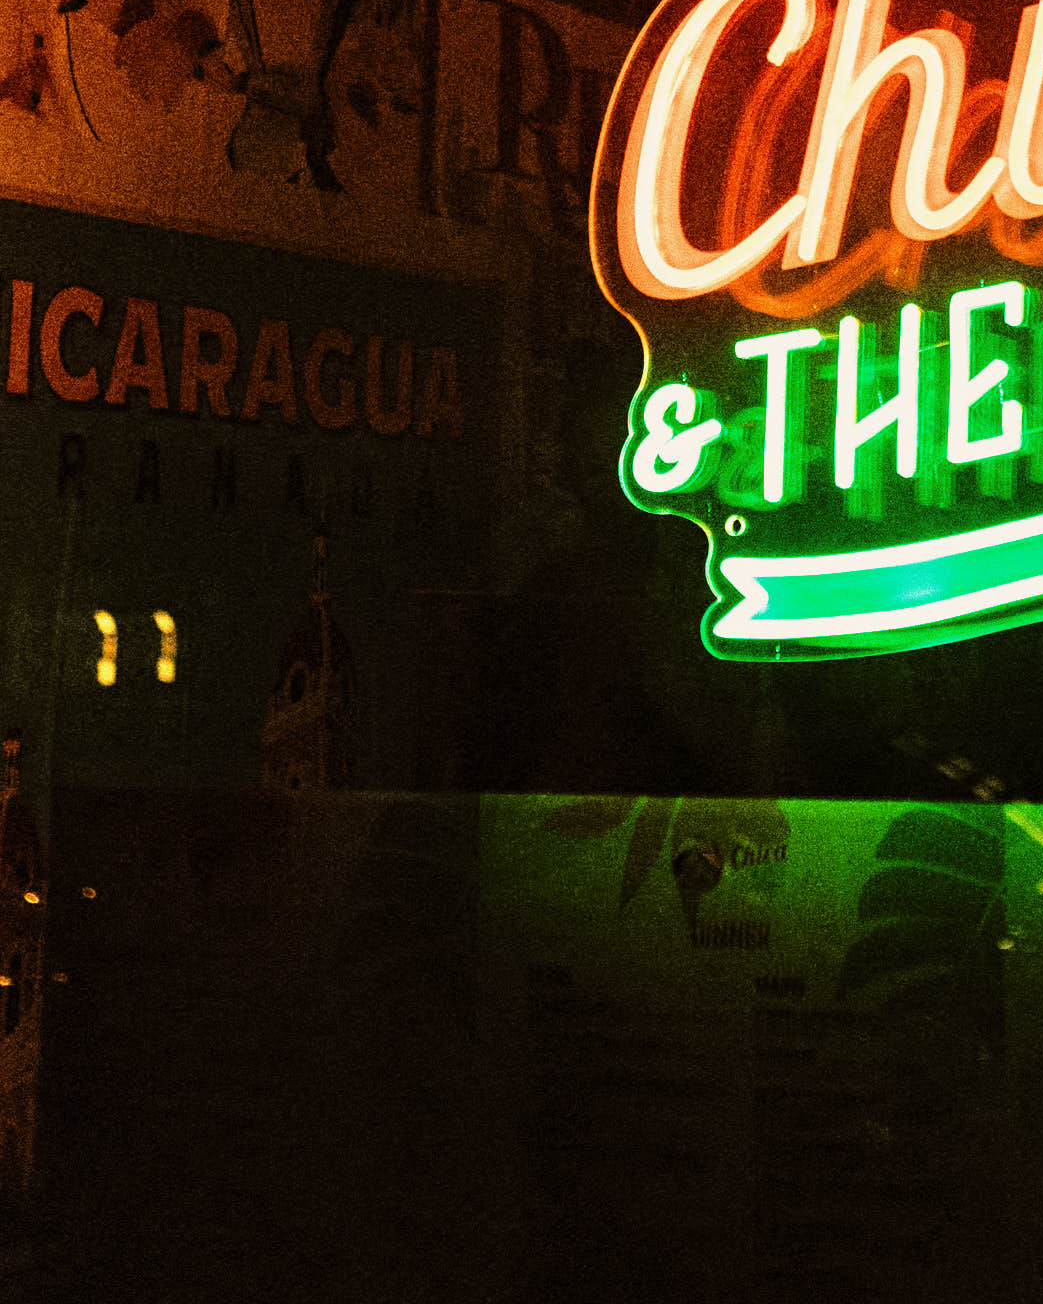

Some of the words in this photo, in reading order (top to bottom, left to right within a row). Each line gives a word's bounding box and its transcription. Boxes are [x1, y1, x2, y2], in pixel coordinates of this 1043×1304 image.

[6, 279, 466, 439] ICARAGUA
[632, 381, 721, 494] &
[734, 279, 1028, 503] THE
